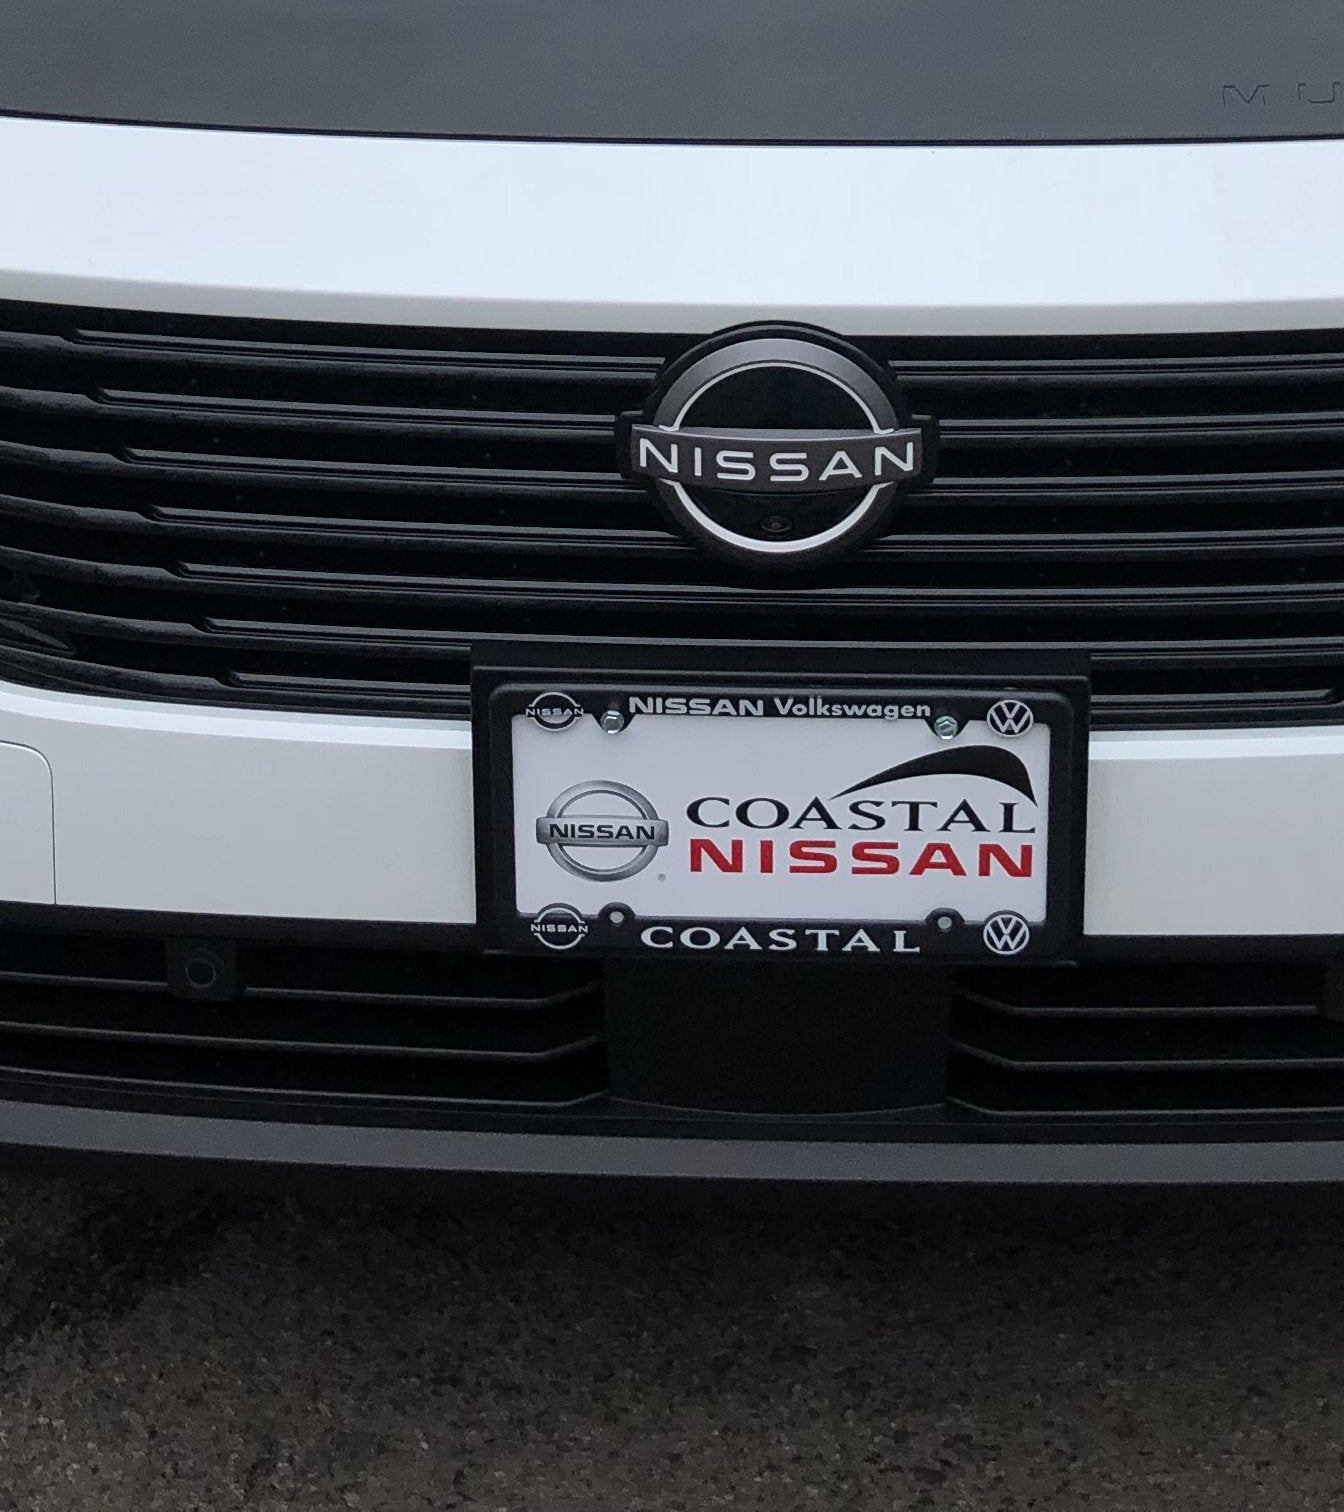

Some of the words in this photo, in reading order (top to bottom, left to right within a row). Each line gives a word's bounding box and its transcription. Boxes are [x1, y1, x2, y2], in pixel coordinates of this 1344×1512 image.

[639, 437, 914, 482] NISSAN
[525, 707, 584, 717] NISSAN
[629, 696, 764, 716] NISSAN
[774, 696, 931, 720] Volkswagen
[685, 796, 1036, 834] COASTAL
[549, 822, 655, 841] NISSAN
[690, 838, 1033, 878] NISSAN
[531, 922, 588, 934] NISSAN
[640, 926, 920, 953] COASTAL
